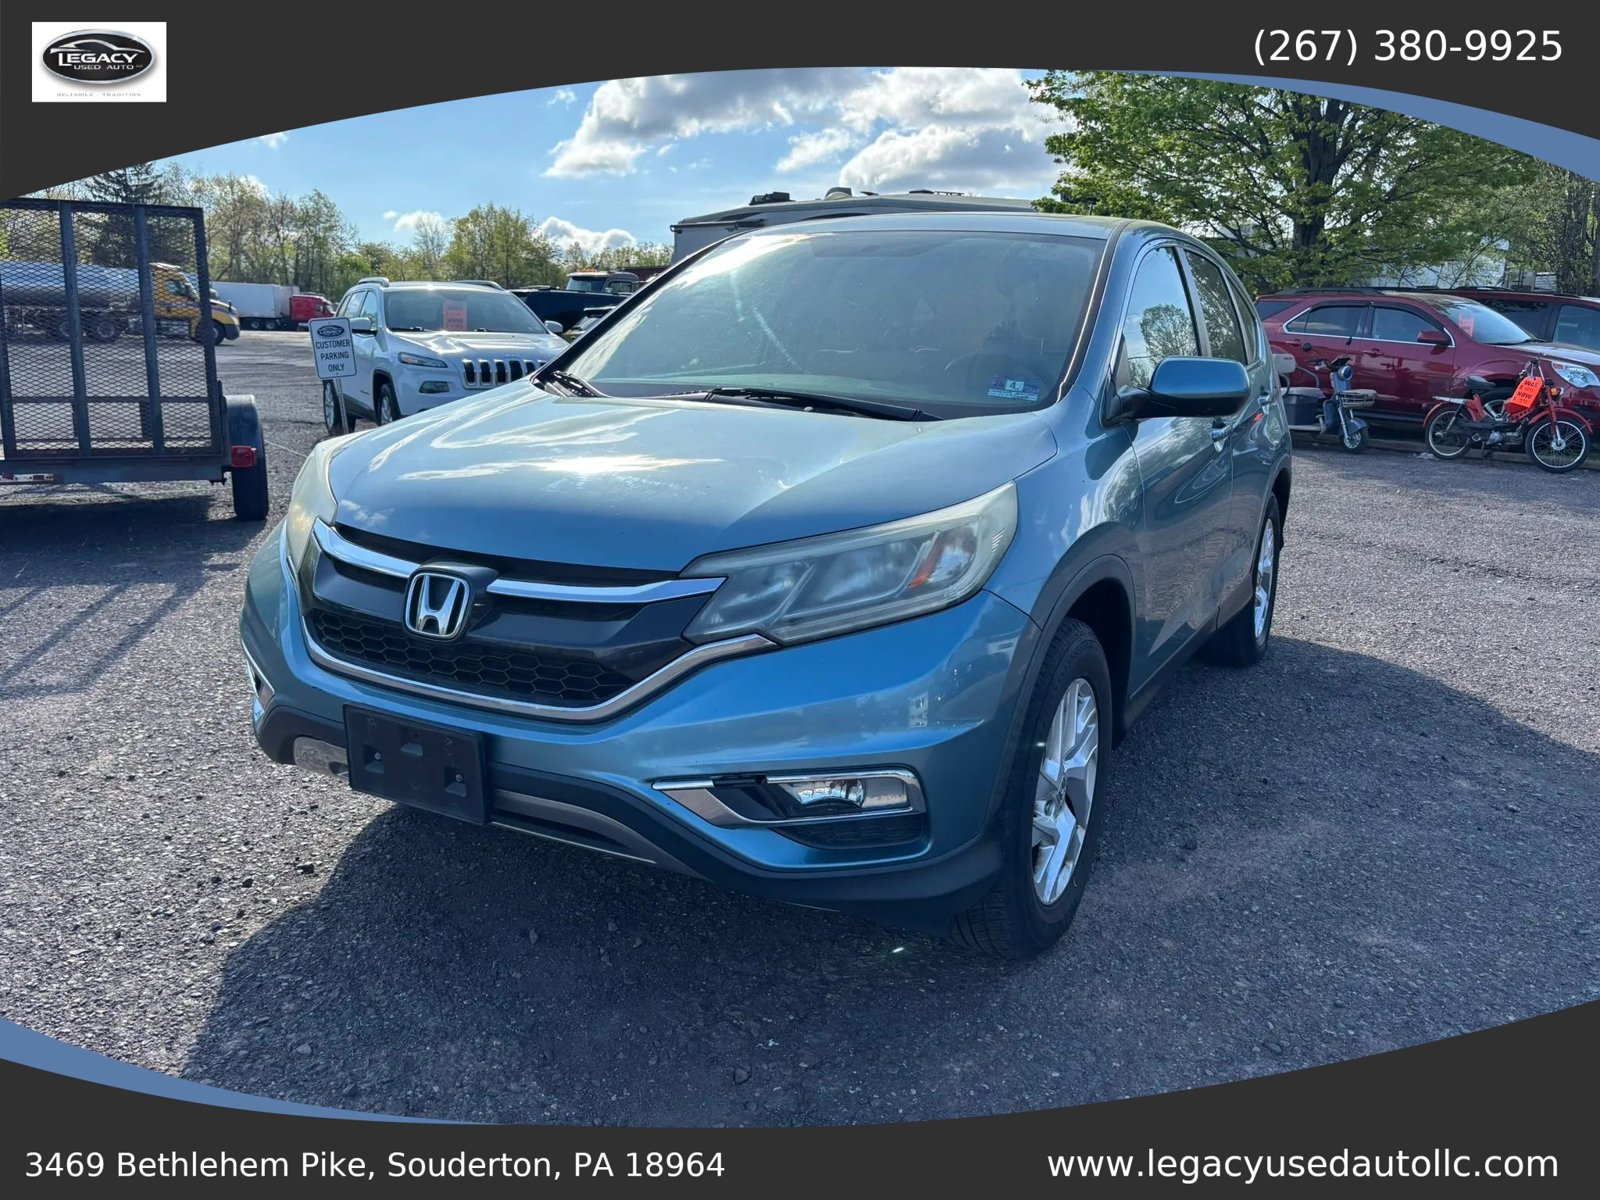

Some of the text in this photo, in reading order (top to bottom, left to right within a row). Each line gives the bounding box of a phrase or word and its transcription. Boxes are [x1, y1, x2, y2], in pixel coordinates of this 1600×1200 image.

[315, 339, 350, 349] CUSTOMER
[320, 351, 349, 361] PARKING
[328, 363, 344, 372] ONLY
[1524, 380, 1538, 388] WAS
[1516, 391, 1532, 399] NOW
